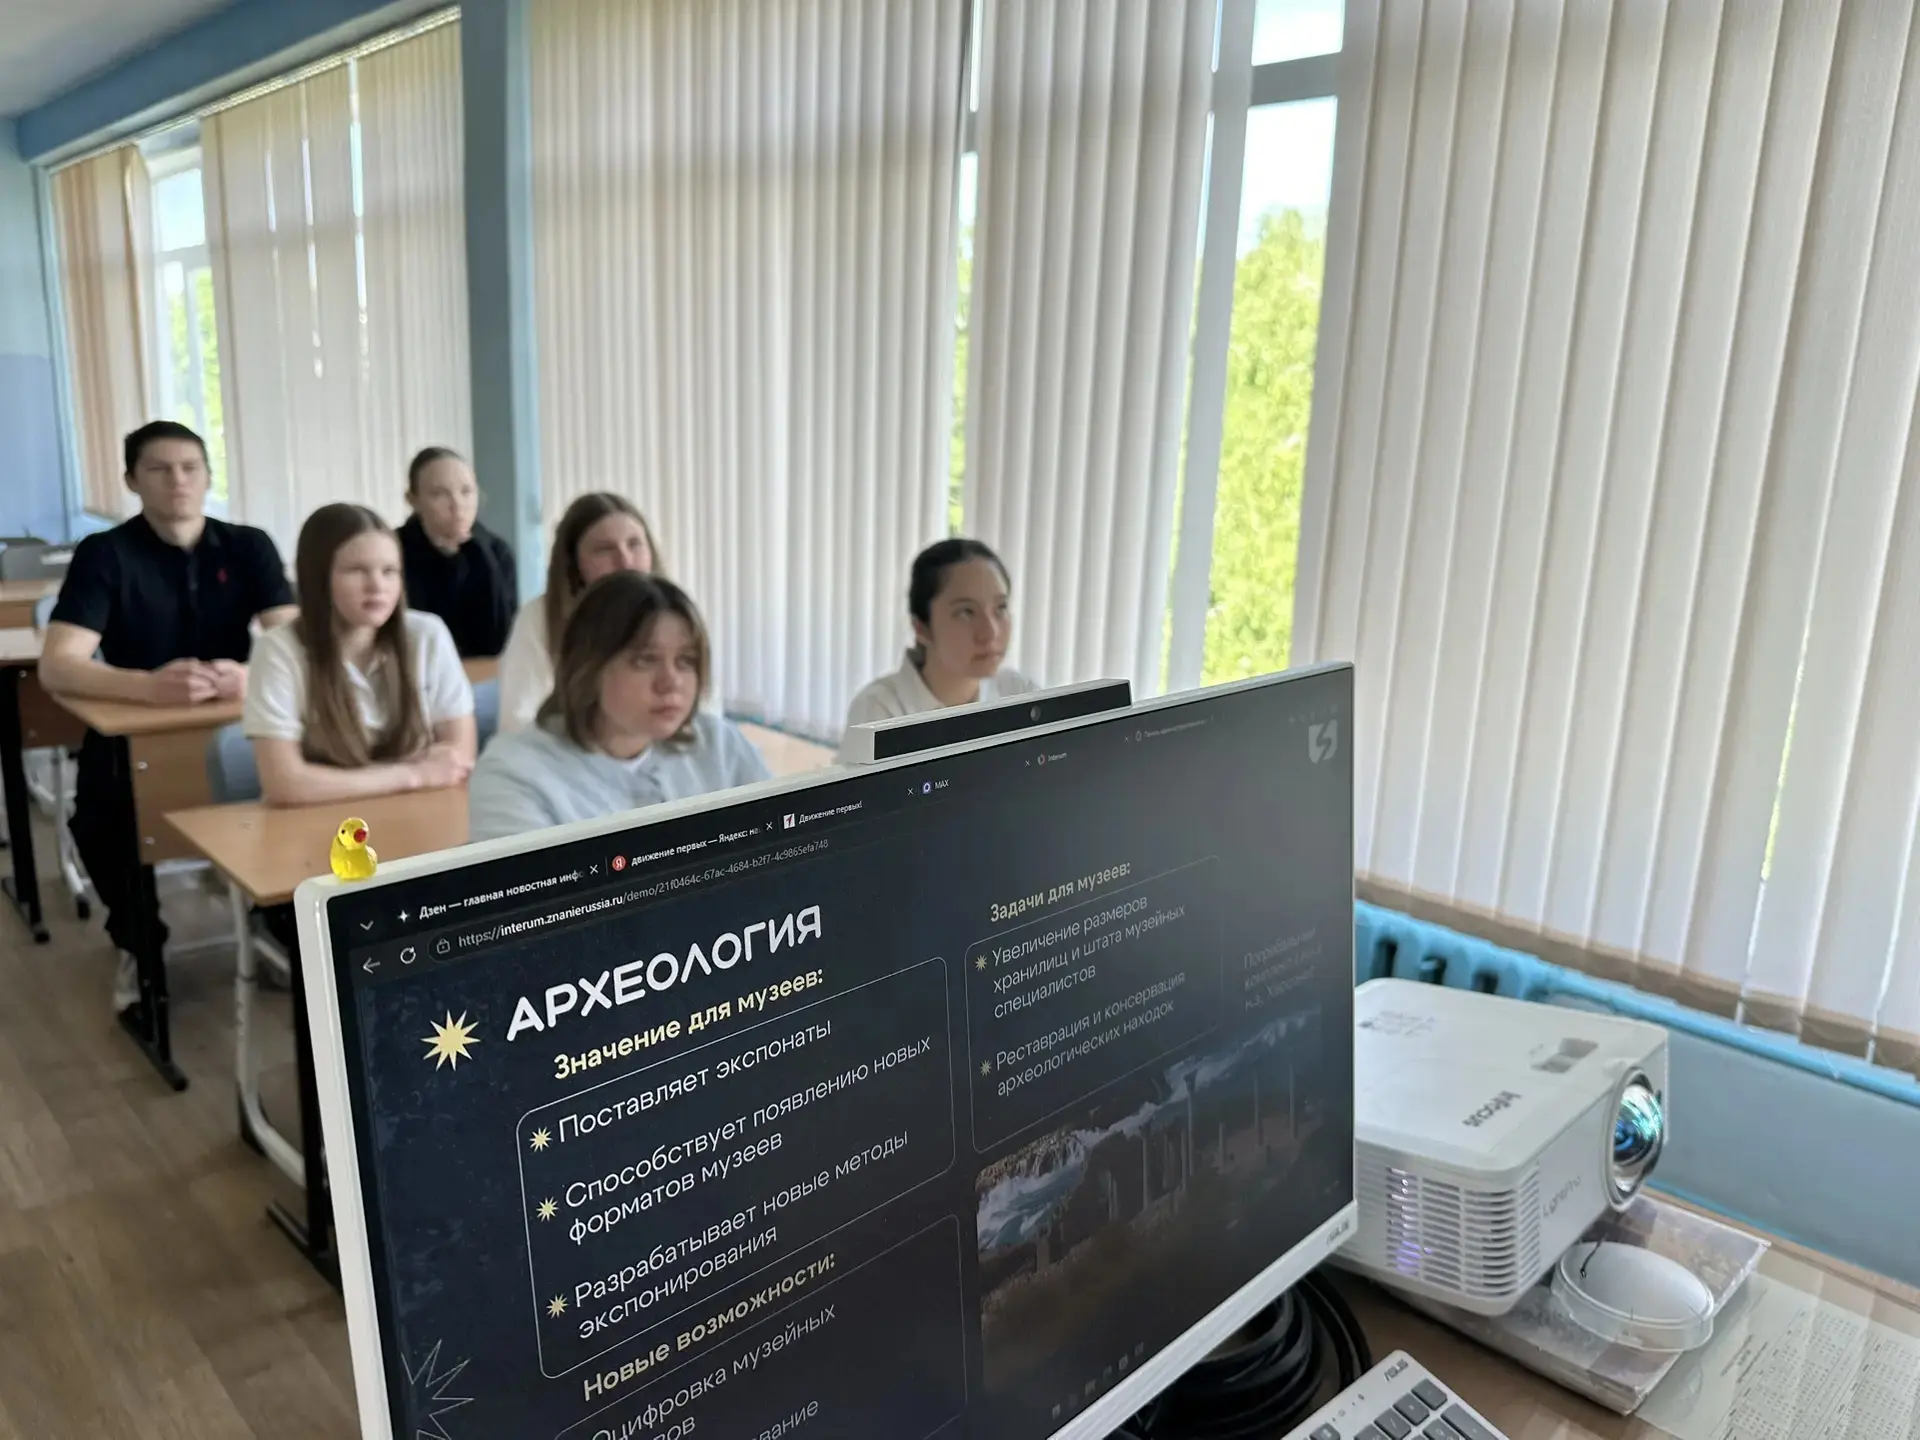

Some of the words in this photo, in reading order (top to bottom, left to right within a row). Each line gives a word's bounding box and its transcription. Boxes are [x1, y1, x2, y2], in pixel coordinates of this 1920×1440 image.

[799, 808, 835, 824] Движение
[836, 801, 863, 815] первых!
[934, 779, 949, 789] MAX
[419, 904, 447, 920] Дзен
[463, 890, 504, 907] главная
[506, 877, 557, 897] новостная
[631, 848, 675, 867] движение
[676, 839, 707, 854] первых
[990, 889, 1044, 923] Задачи
[1047, 882, 1074, 904] для
[1078, 861, 1131, 892] музеев:
[506, 905, 821, 1041] АРХЕОЛОГИЯ
[992, 923, 1080, 968] Увеличение
[1083, 896, 1148, 933] размеров
[993, 952, 1068, 994] хранилищ
[1071, 946, 1081, 961] и
[1083, 930, 1122, 956] штата
[1125, 904, 1186, 943] музейных
[553, 1017, 681, 1080] Значение
[687, 1000, 731, 1031] для
[738, 968, 824, 1014] музеев:
[994, 965, 1096, 1019] специалистов
[996, 1016, 1090, 1071] Реставрация
[1092, 1010, 1101, 1025] и
[1104, 971, 1186, 1020] консервация
[558, 1070, 709, 1142] Поставляет
[717, 1021, 832, 1079] экспонаты
[997, 1025, 1120, 1097] археологических
[1123, 1000, 1175, 1038] находок
[565, 1116, 747, 1208] Способствует
[754, 1063, 868, 1128] появлению
[873, 1037, 931, 1074] новых
[569, 1173, 695, 1245] форматов
[701, 1133, 783, 1184] музеев
[574, 1208, 756, 1307] Разрабатывает
[763, 1170, 829, 1215] новые
[835, 1130, 909, 1179] методы
[578, 1226, 777, 1339] экспонирования
[584, 1344, 670, 1401] Новые
[677, 1253, 836, 1352] возможности:
[733, 1304, 836, 1375] музейных
